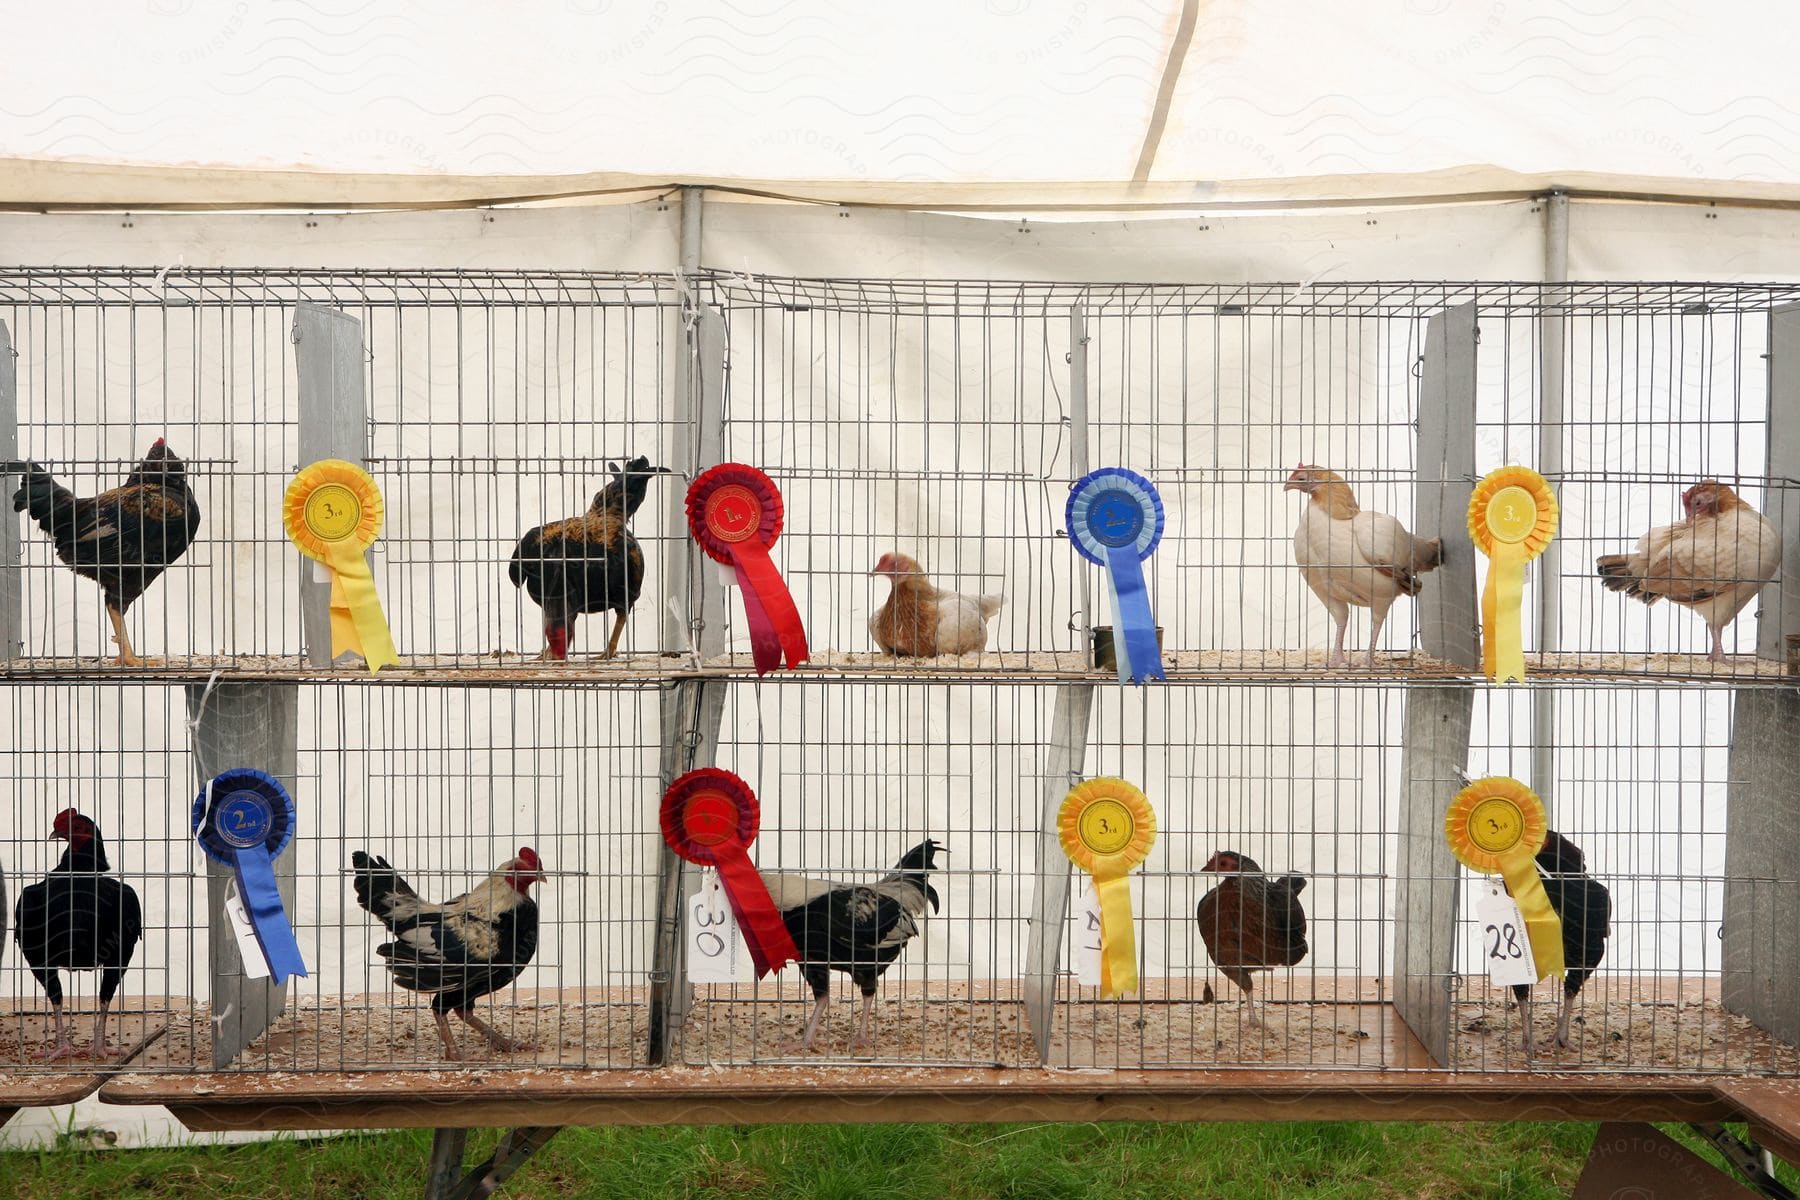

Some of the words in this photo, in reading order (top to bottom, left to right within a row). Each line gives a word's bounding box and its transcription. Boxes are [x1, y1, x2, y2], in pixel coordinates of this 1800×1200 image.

[232, 809, 257, 830] 2nd
[1098, 818, 1117, 834] 3rd
[1487, 818, 1509, 835] 3rd
[694, 904, 725, 957] 30
[1485, 923, 1523, 961] 28
